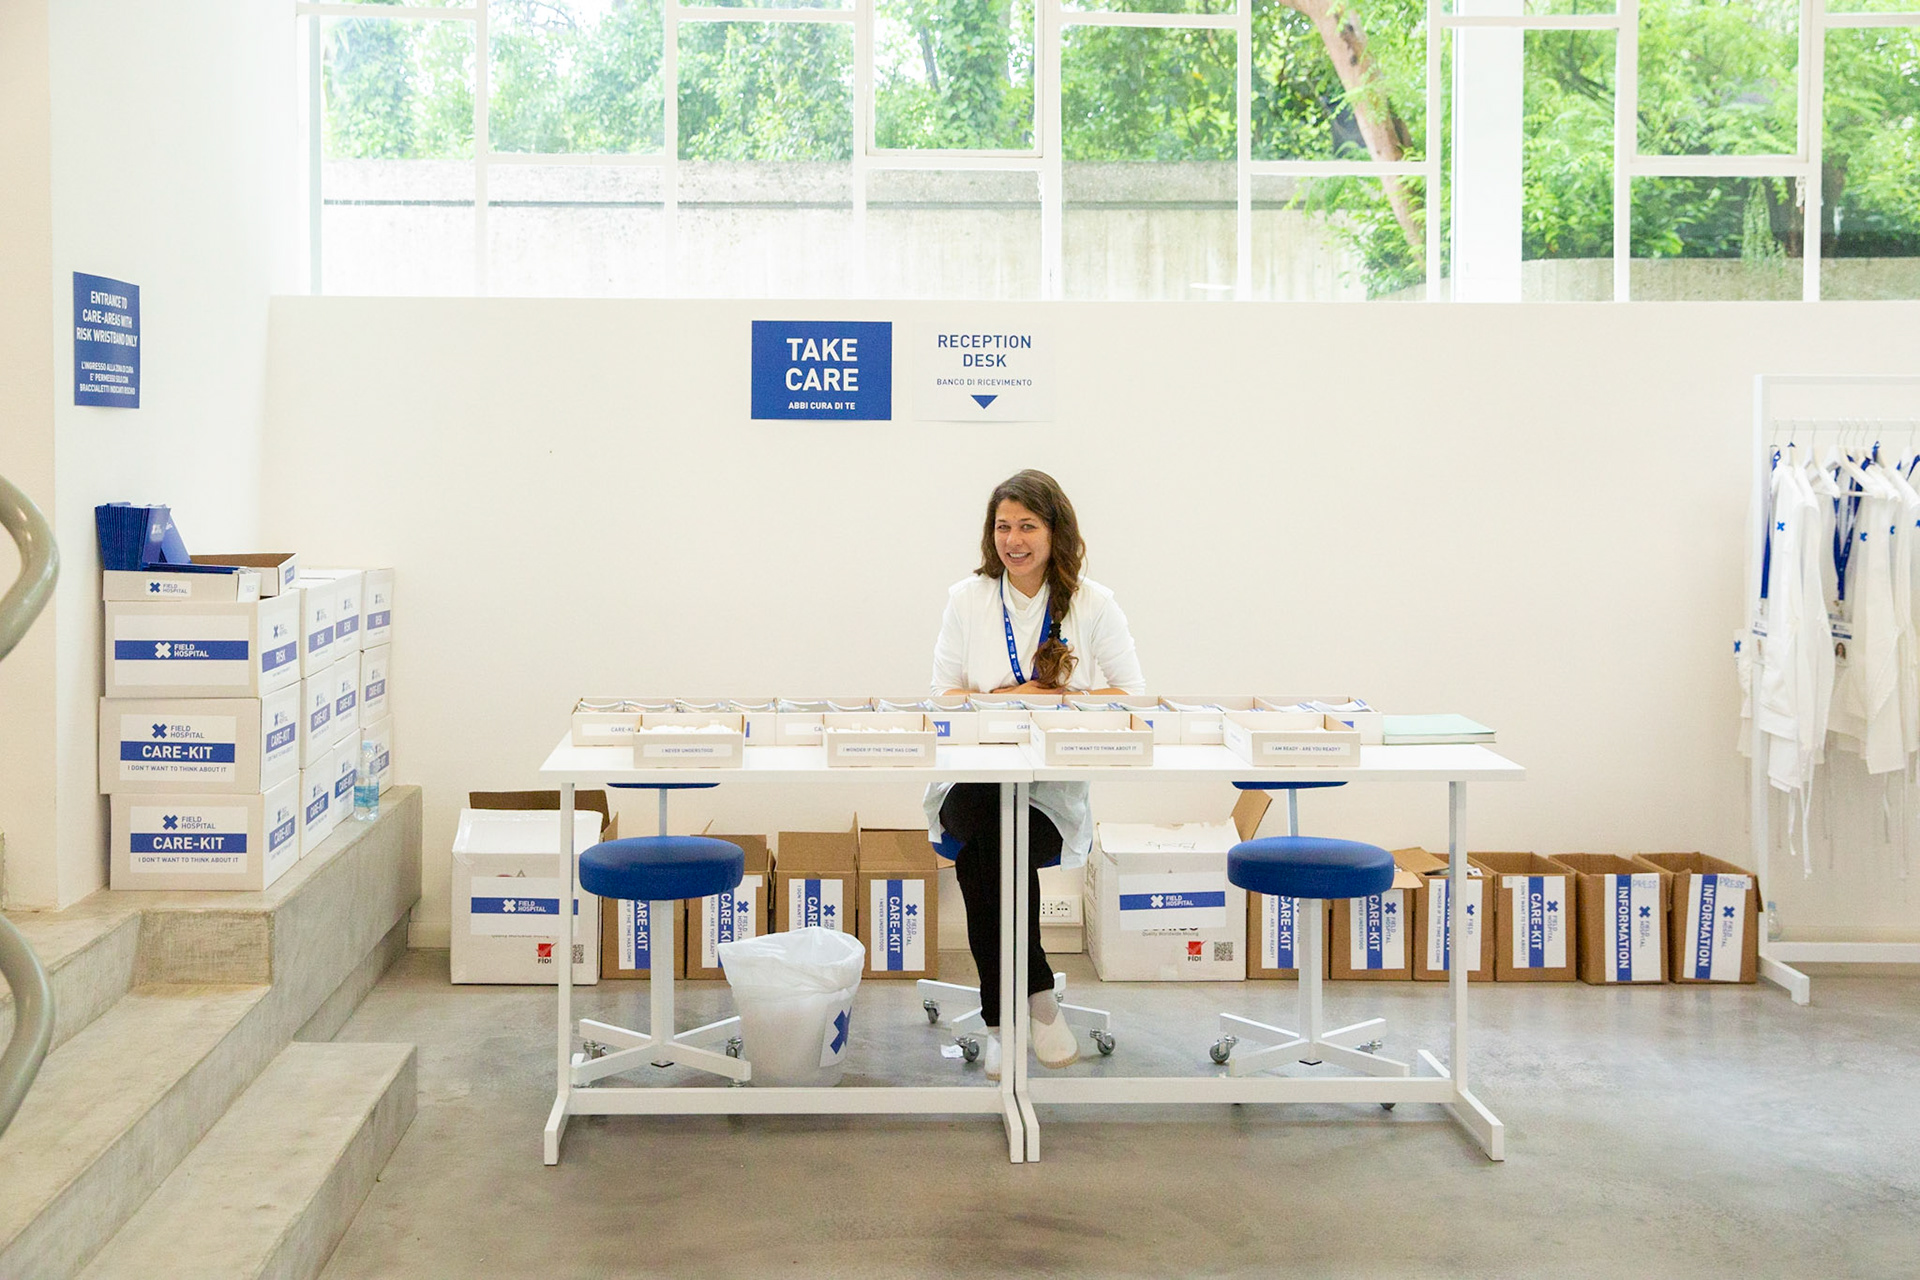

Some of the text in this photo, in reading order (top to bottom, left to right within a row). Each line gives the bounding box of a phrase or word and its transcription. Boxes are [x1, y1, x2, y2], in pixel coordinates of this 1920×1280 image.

[91, 291, 128, 310] ENTRANCE TO
[83, 309, 121, 326] CARE-AREAS
[77, 327, 138, 347] RISK WRISTBAND ONLY
[938, 334, 1031, 349] RECEPTION
[786, 338, 858, 361] TAKE
[963, 354, 1007, 367] DESK
[785, 367, 859, 391] CARE
[936, 378, 1033, 386] BANCO DI RICEVIMENTO
[788, 402, 856, 410] ABBI CURA DI TE
[174, 650, 209, 658] HOSPITAL
[276, 649, 286, 664] RISK
[142, 745, 213, 759] CARE-KIT
[153, 837, 225, 850] CARE-KIT
[1633, 880, 1657, 889] PRESS
[1719, 877, 1745, 889] PRESS
[721, 893, 731, 942] CARE-KI
[807, 897, 818, 928] CARE
[1531, 893, 1542, 950] CARE-KIT
[637, 900, 648, 951] ARE-KIT
[890, 896, 900, 953] CARE-KIT
[1281, 896, 1292, 951] CARE-KIT
[1370, 895, 1380, 952] CARE-KIT
[1618, 886, 1630, 969] INFORMATION
[1699, 884, 1715, 967] INFORMATION
